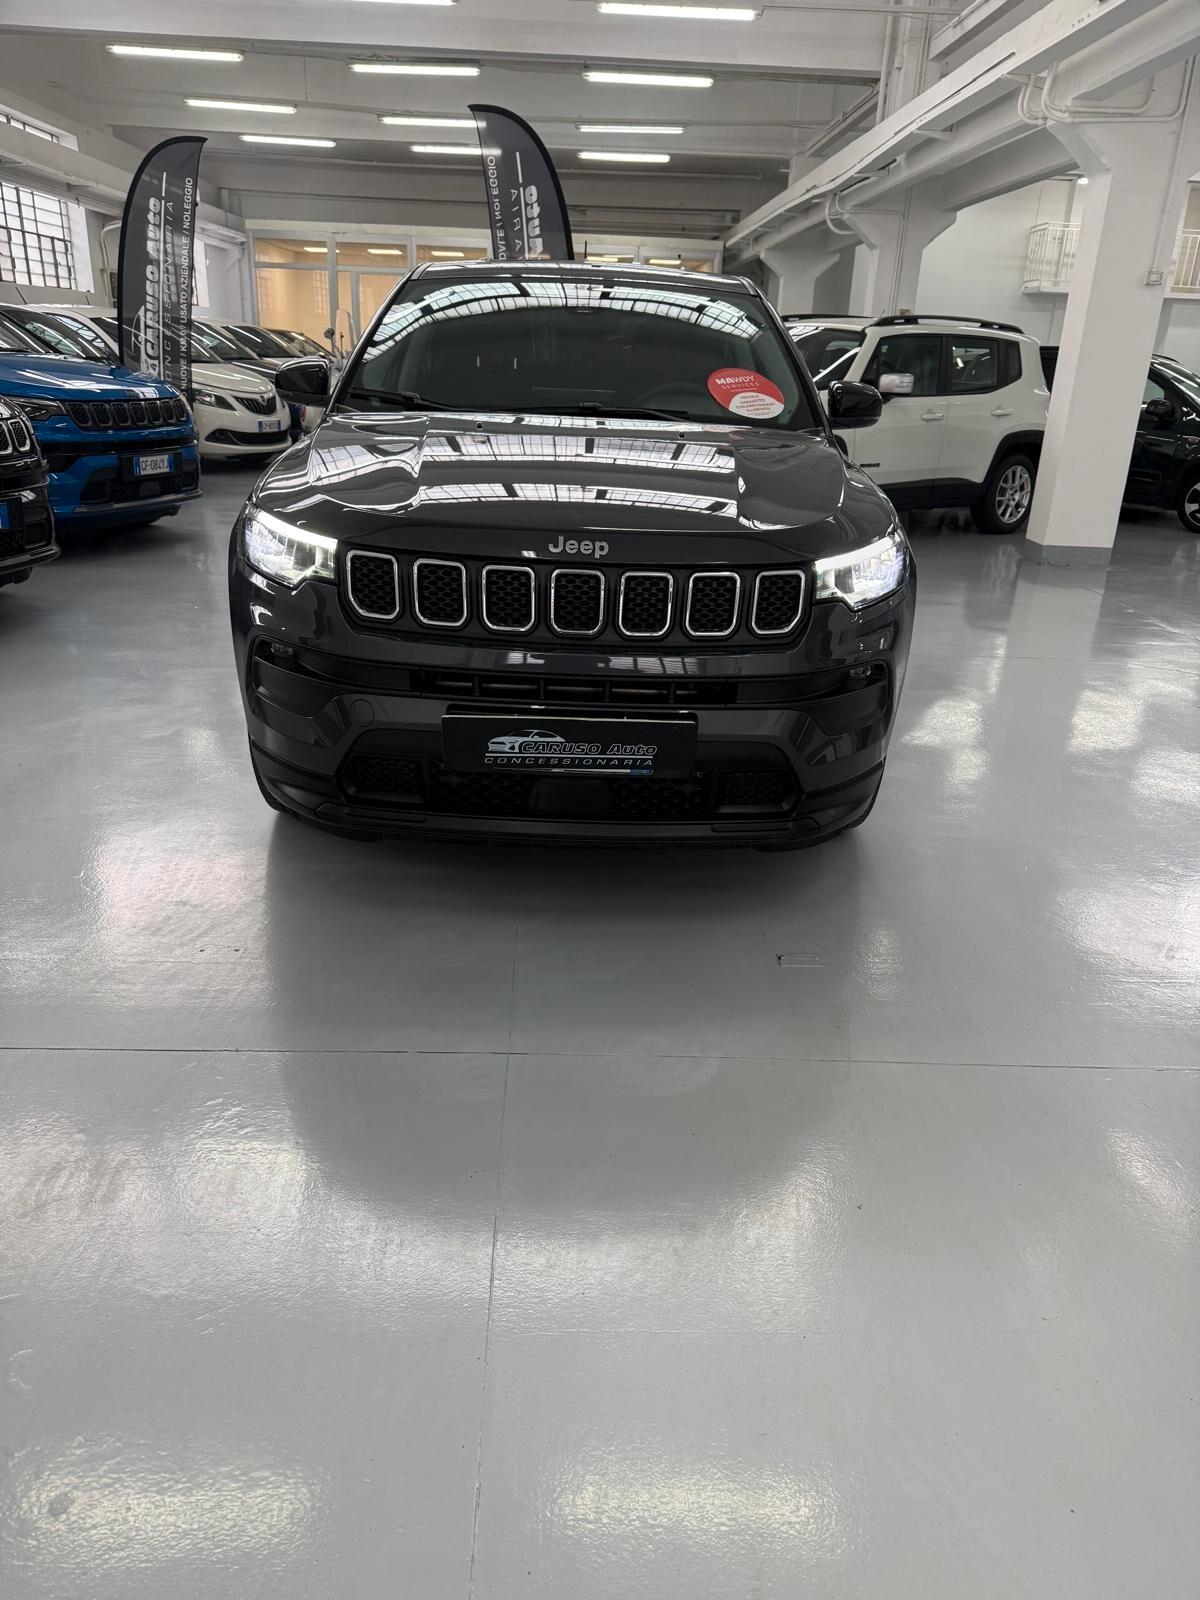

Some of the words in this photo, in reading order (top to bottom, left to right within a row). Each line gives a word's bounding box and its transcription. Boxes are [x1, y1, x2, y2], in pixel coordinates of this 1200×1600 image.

[183, 177, 194, 229] NOLEGGIO
[180, 236, 190, 290] AZIENDALE
[164, 202, 174, 382] ONCESSIONARIA
[145, 264, 159, 358] CARUSO
[180, 291, 188, 323] USATO
[715, 375, 755, 385] MAWDY
[721, 381, 760, 390] SERVICES
[548, 535, 609, 559] Jeep
[484, 757, 653, 766] CONCESSIONARIA
[521, 741, 601, 755] CARUSO
[606, 743, 658, 755] Auto
